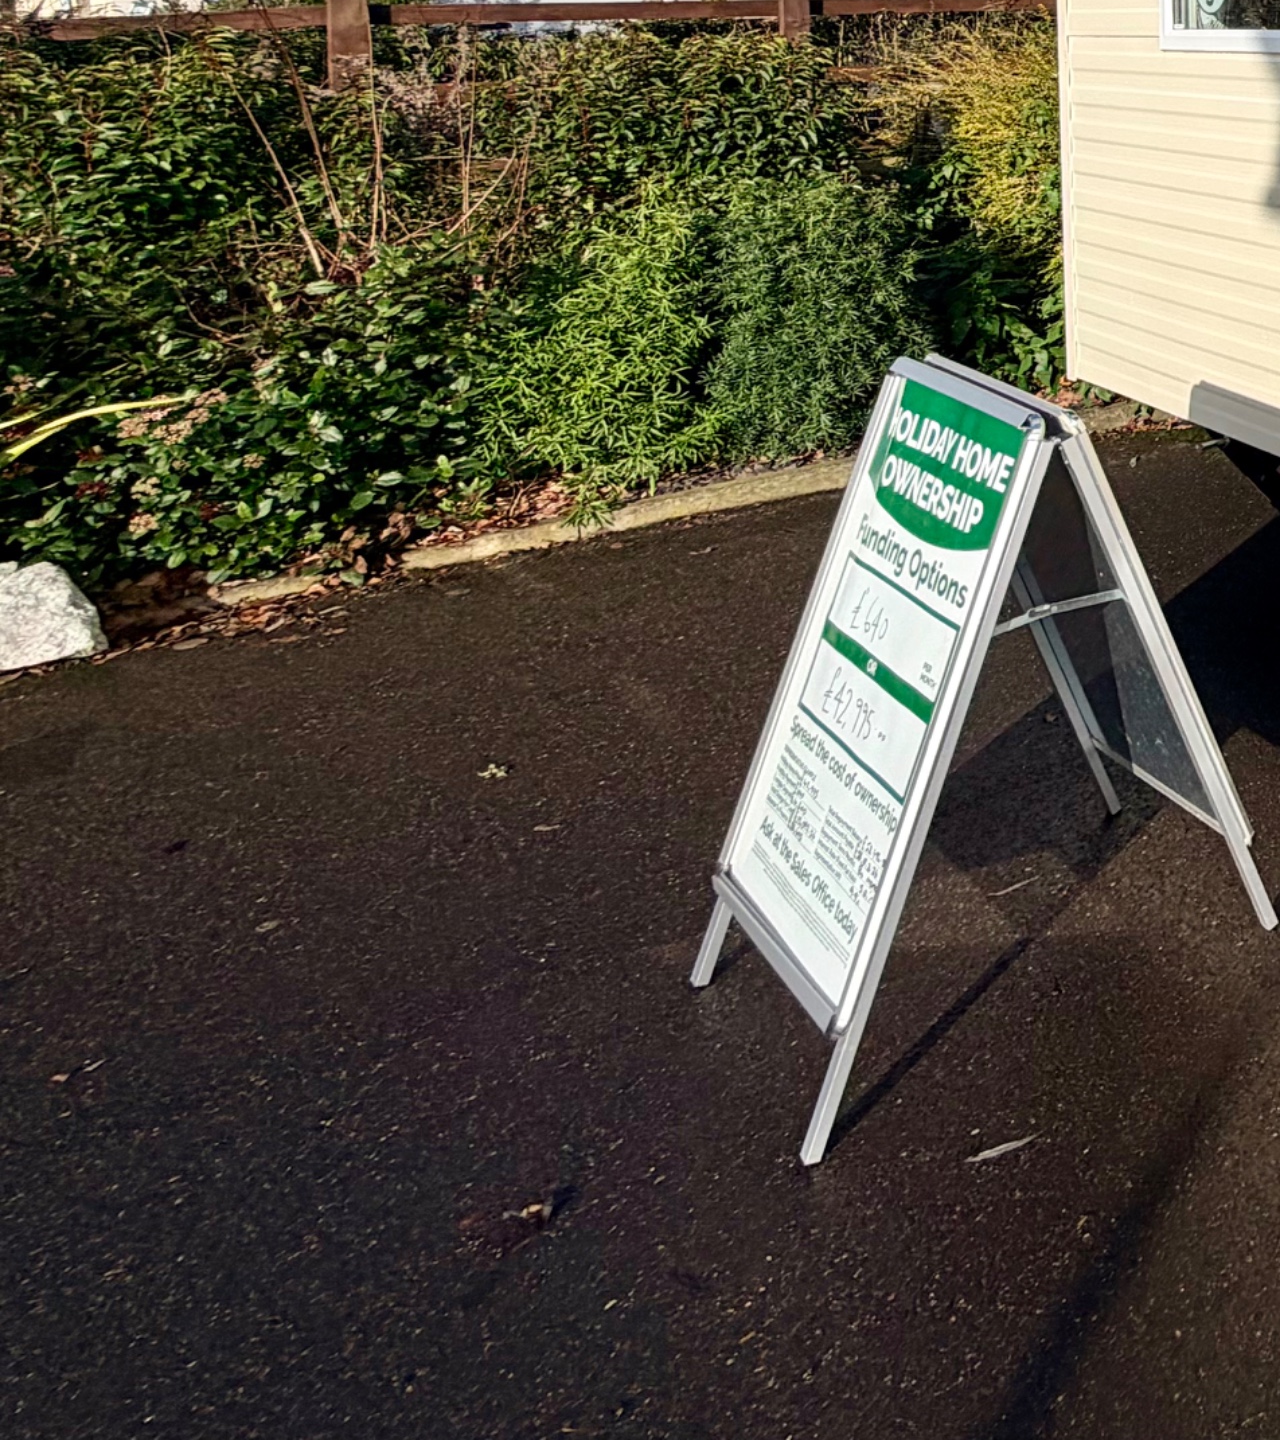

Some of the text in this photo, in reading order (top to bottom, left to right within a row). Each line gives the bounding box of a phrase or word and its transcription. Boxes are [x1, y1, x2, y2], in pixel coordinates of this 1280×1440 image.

[888, 406, 1016, 494] HOLIDAY HOME
[881, 454, 984, 534] OWNERSHIP
[856, 512, 968, 609] Funding Options
[849, 587, 889, 643] £640
[866, 658, 878, 677] OR
[919, 672, 938, 691] MONTH
[922, 661, 933, 674] PER
[789, 714, 899, 835] Spread the cost of ownership
[759, 815, 859, 945] Ask at the Sales Office today
